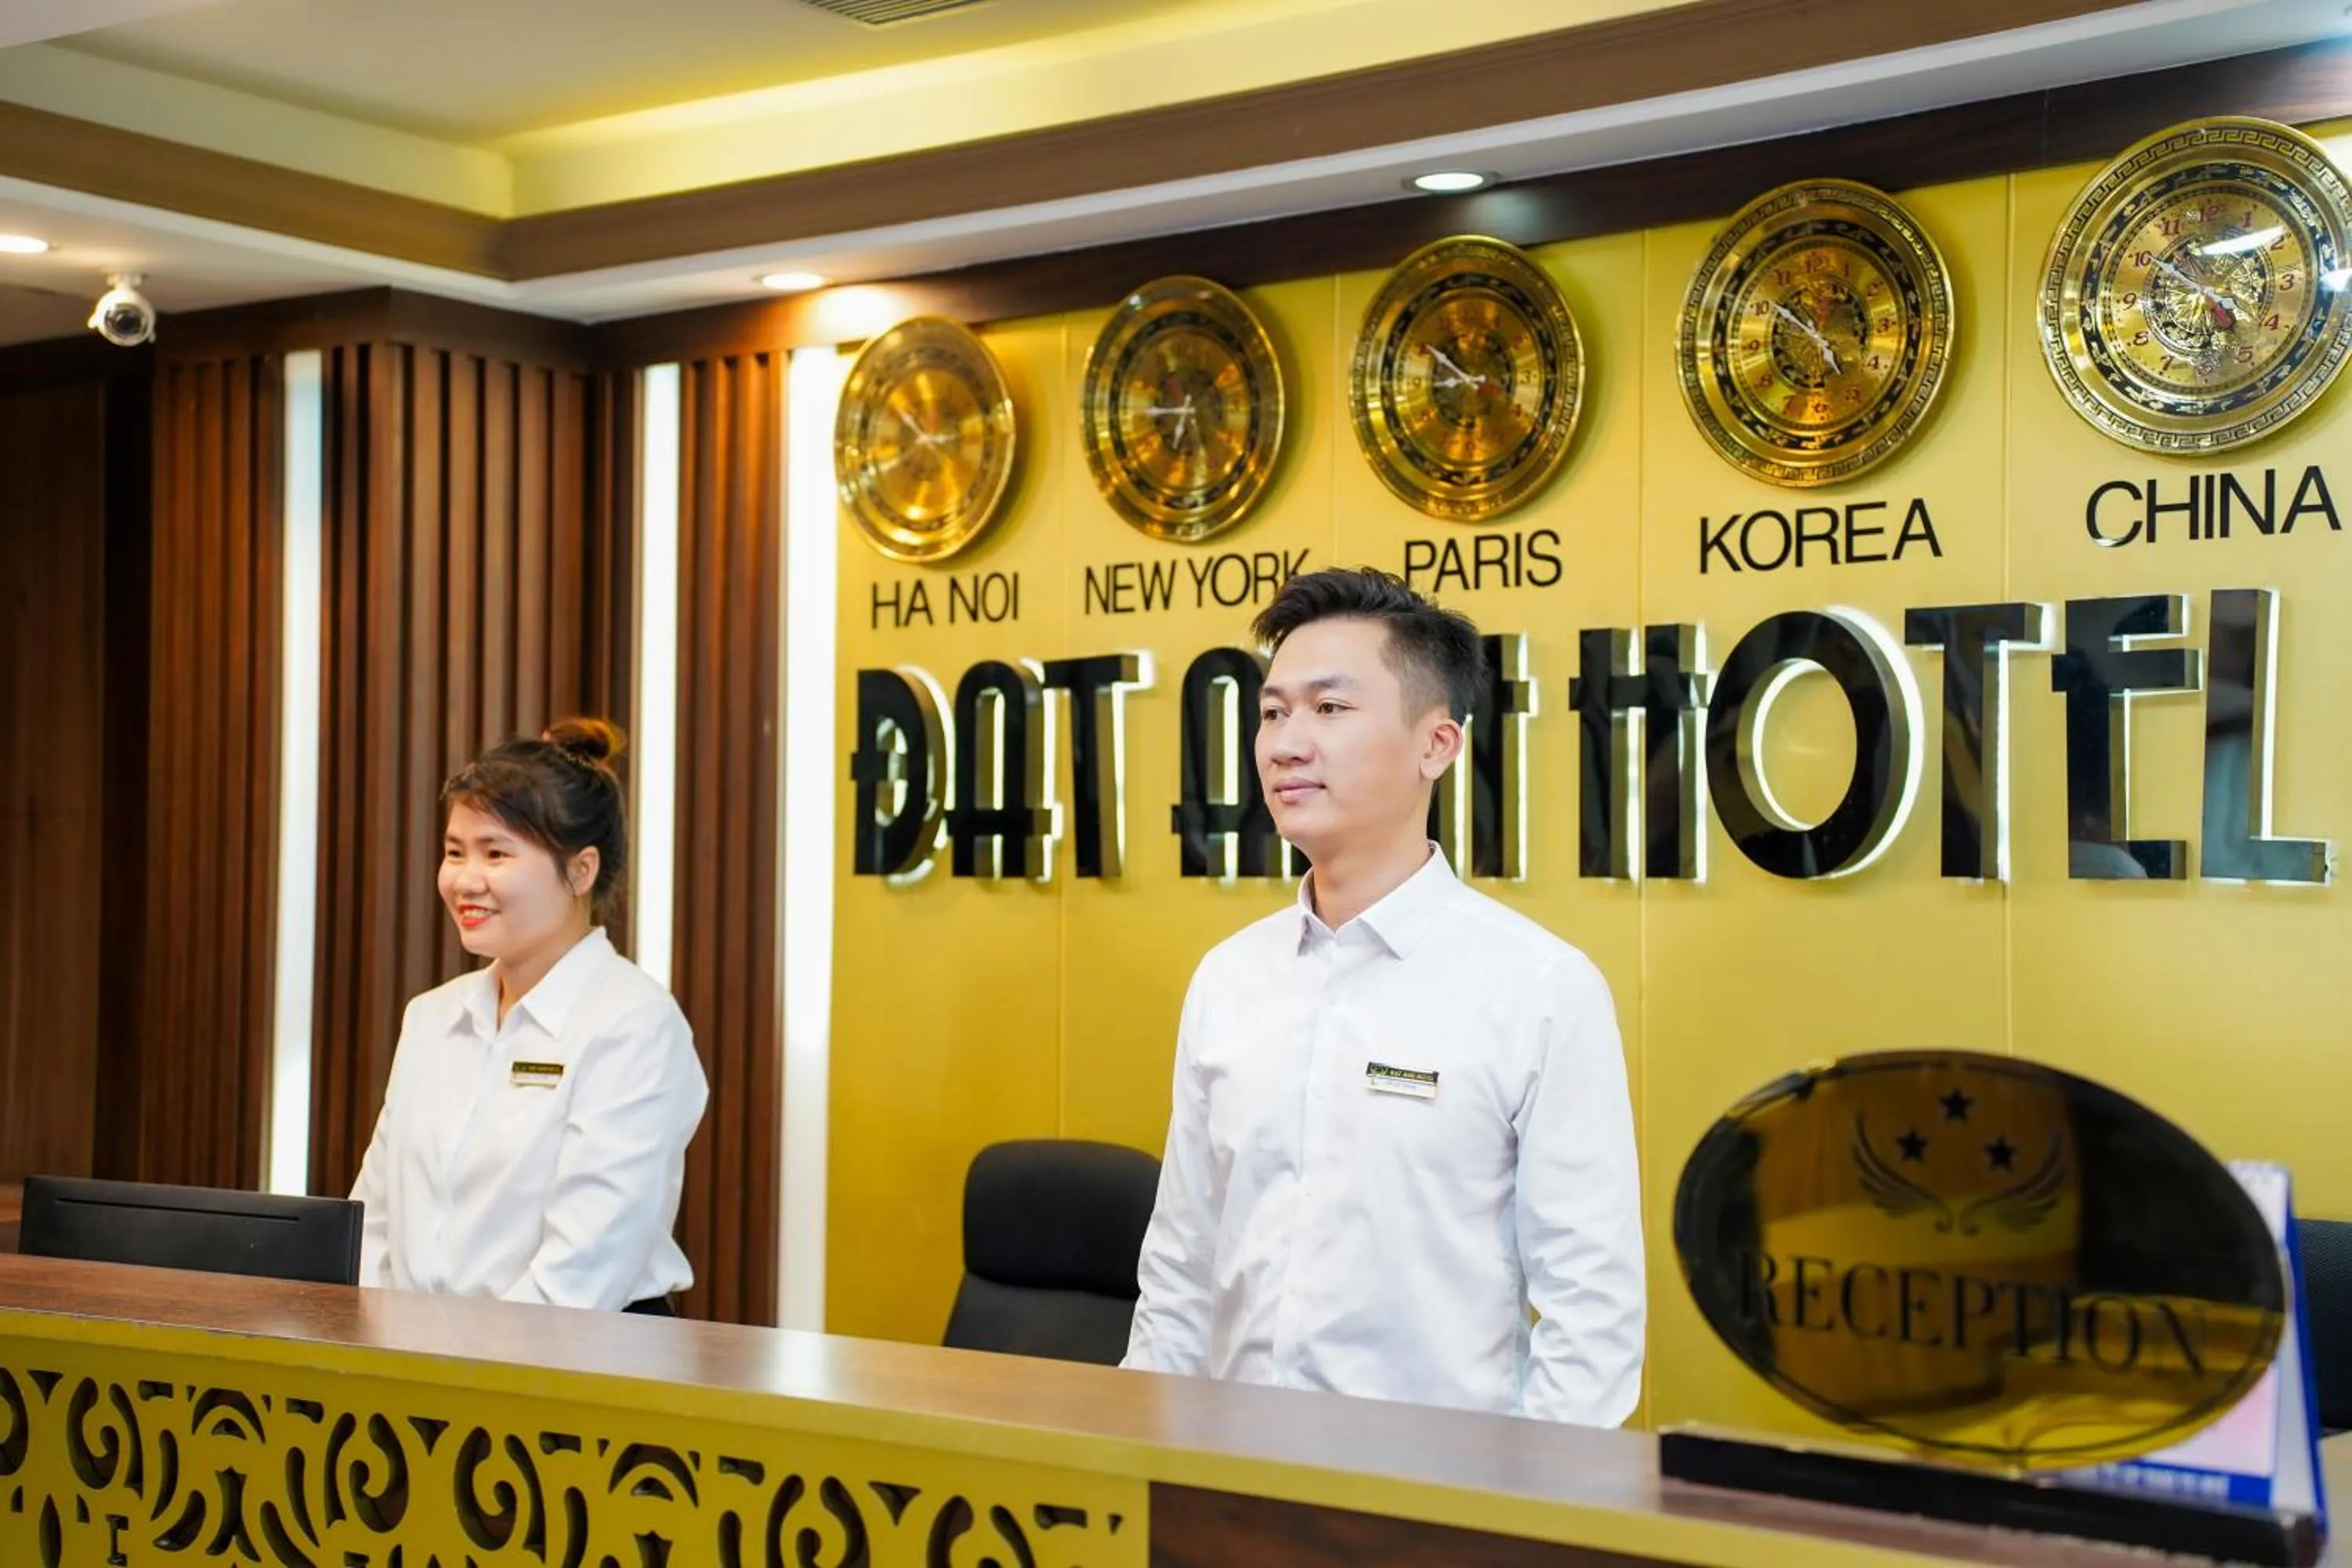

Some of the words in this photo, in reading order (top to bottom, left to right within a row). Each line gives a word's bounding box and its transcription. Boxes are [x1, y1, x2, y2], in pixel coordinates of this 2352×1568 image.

[2200, 205, 2220, 222] 12
[2241, 212, 2253, 228] 1
[2155, 220, 2180, 236] 11
[2135, 250, 2152, 267] 10
[2280, 274, 2294, 291] 3
[2123, 292, 2136, 310] 9
[2264, 314, 2279, 330] 4
[2132, 331, 2149, 346] 8
[2235, 347, 2253, 363] 5
[2085, 465, 2343, 548] CHINA
[1699, 498, 1942, 574] KOREA
[1405, 528, 1563, 593] PARIS
[1085, 560, 1176, 615] NEW
[870, 578, 935, 630] HA
[949, 572, 1019, 625] NOI
[1171, 632, 1527, 879] AH
[1568, 588, 2330, 881] HOTEL
[1736, 1251, 2207, 1378] RECEPTION
